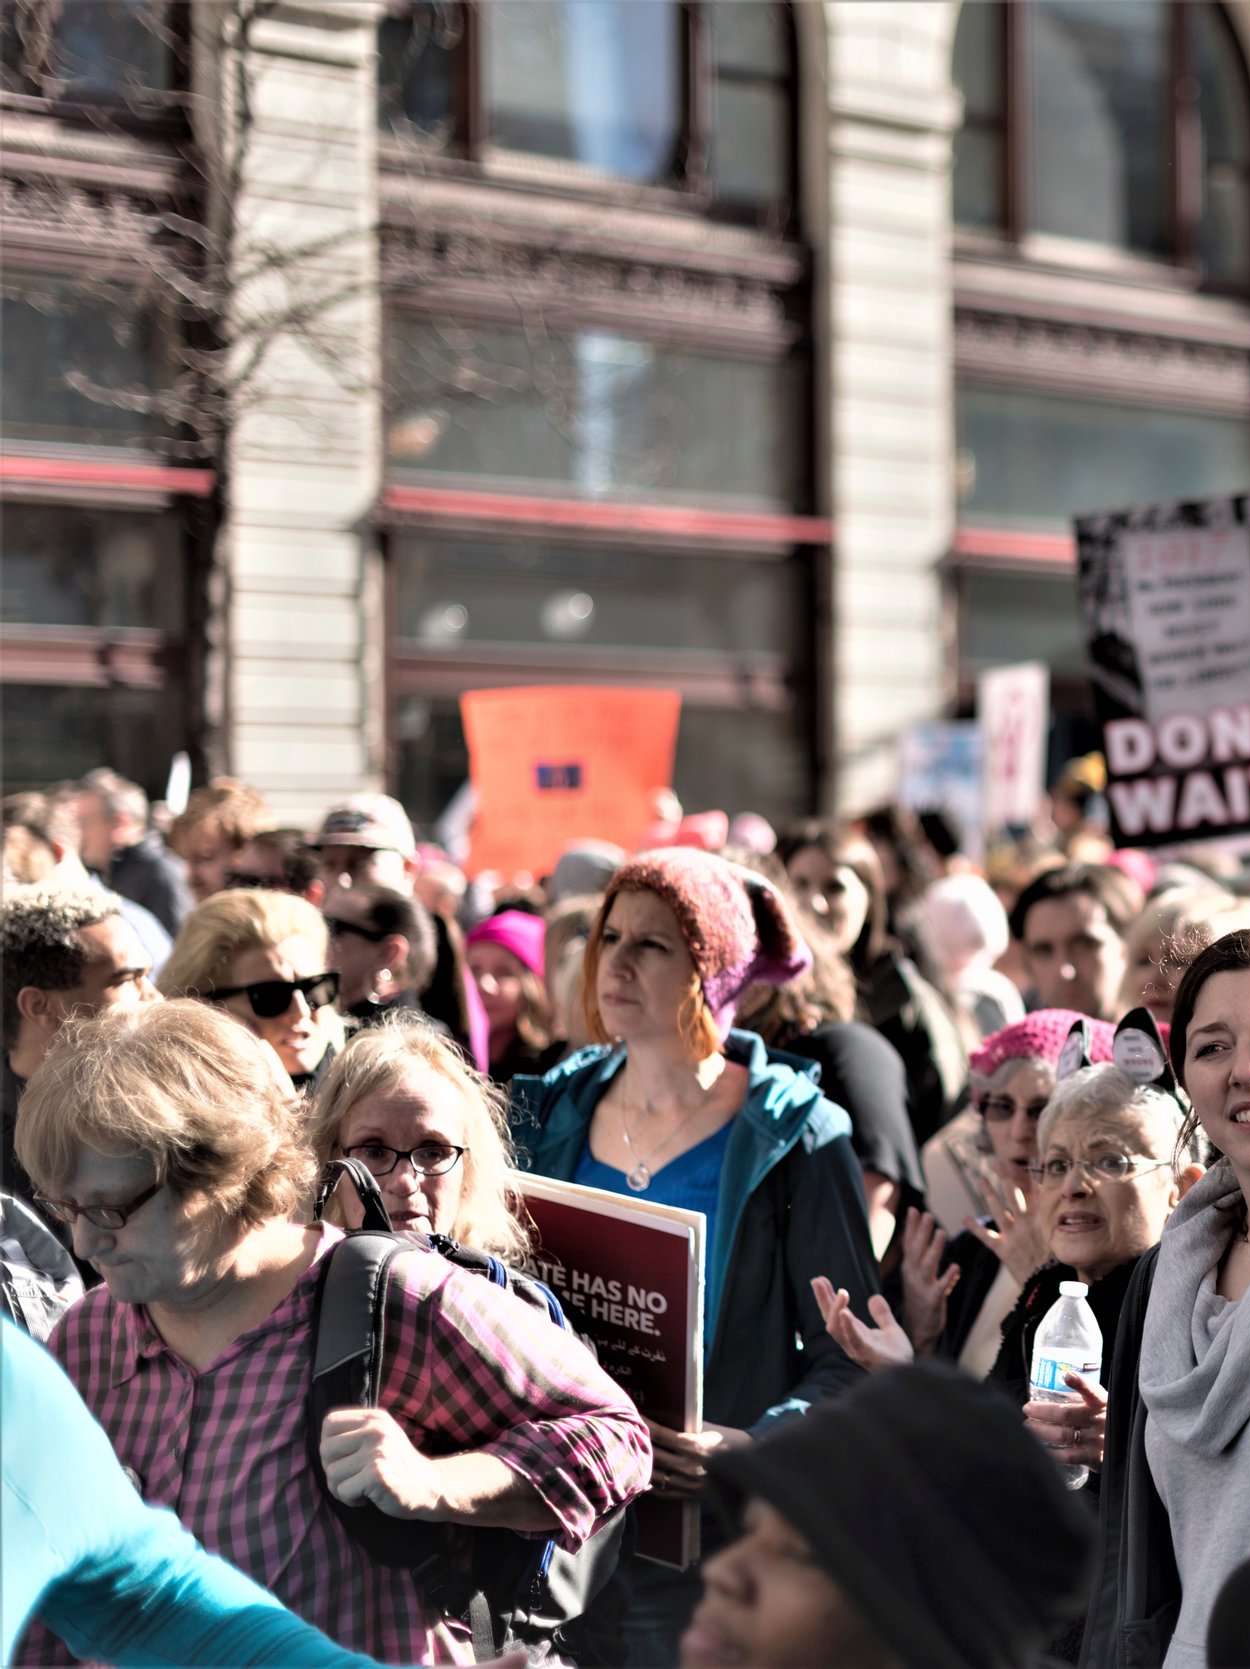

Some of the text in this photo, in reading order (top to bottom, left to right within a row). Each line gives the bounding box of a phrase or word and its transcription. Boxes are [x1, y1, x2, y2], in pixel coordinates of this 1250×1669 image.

[512, 1257, 668, 1314] ATE HAS NO
[591, 1298, 662, 1337] HERE.
